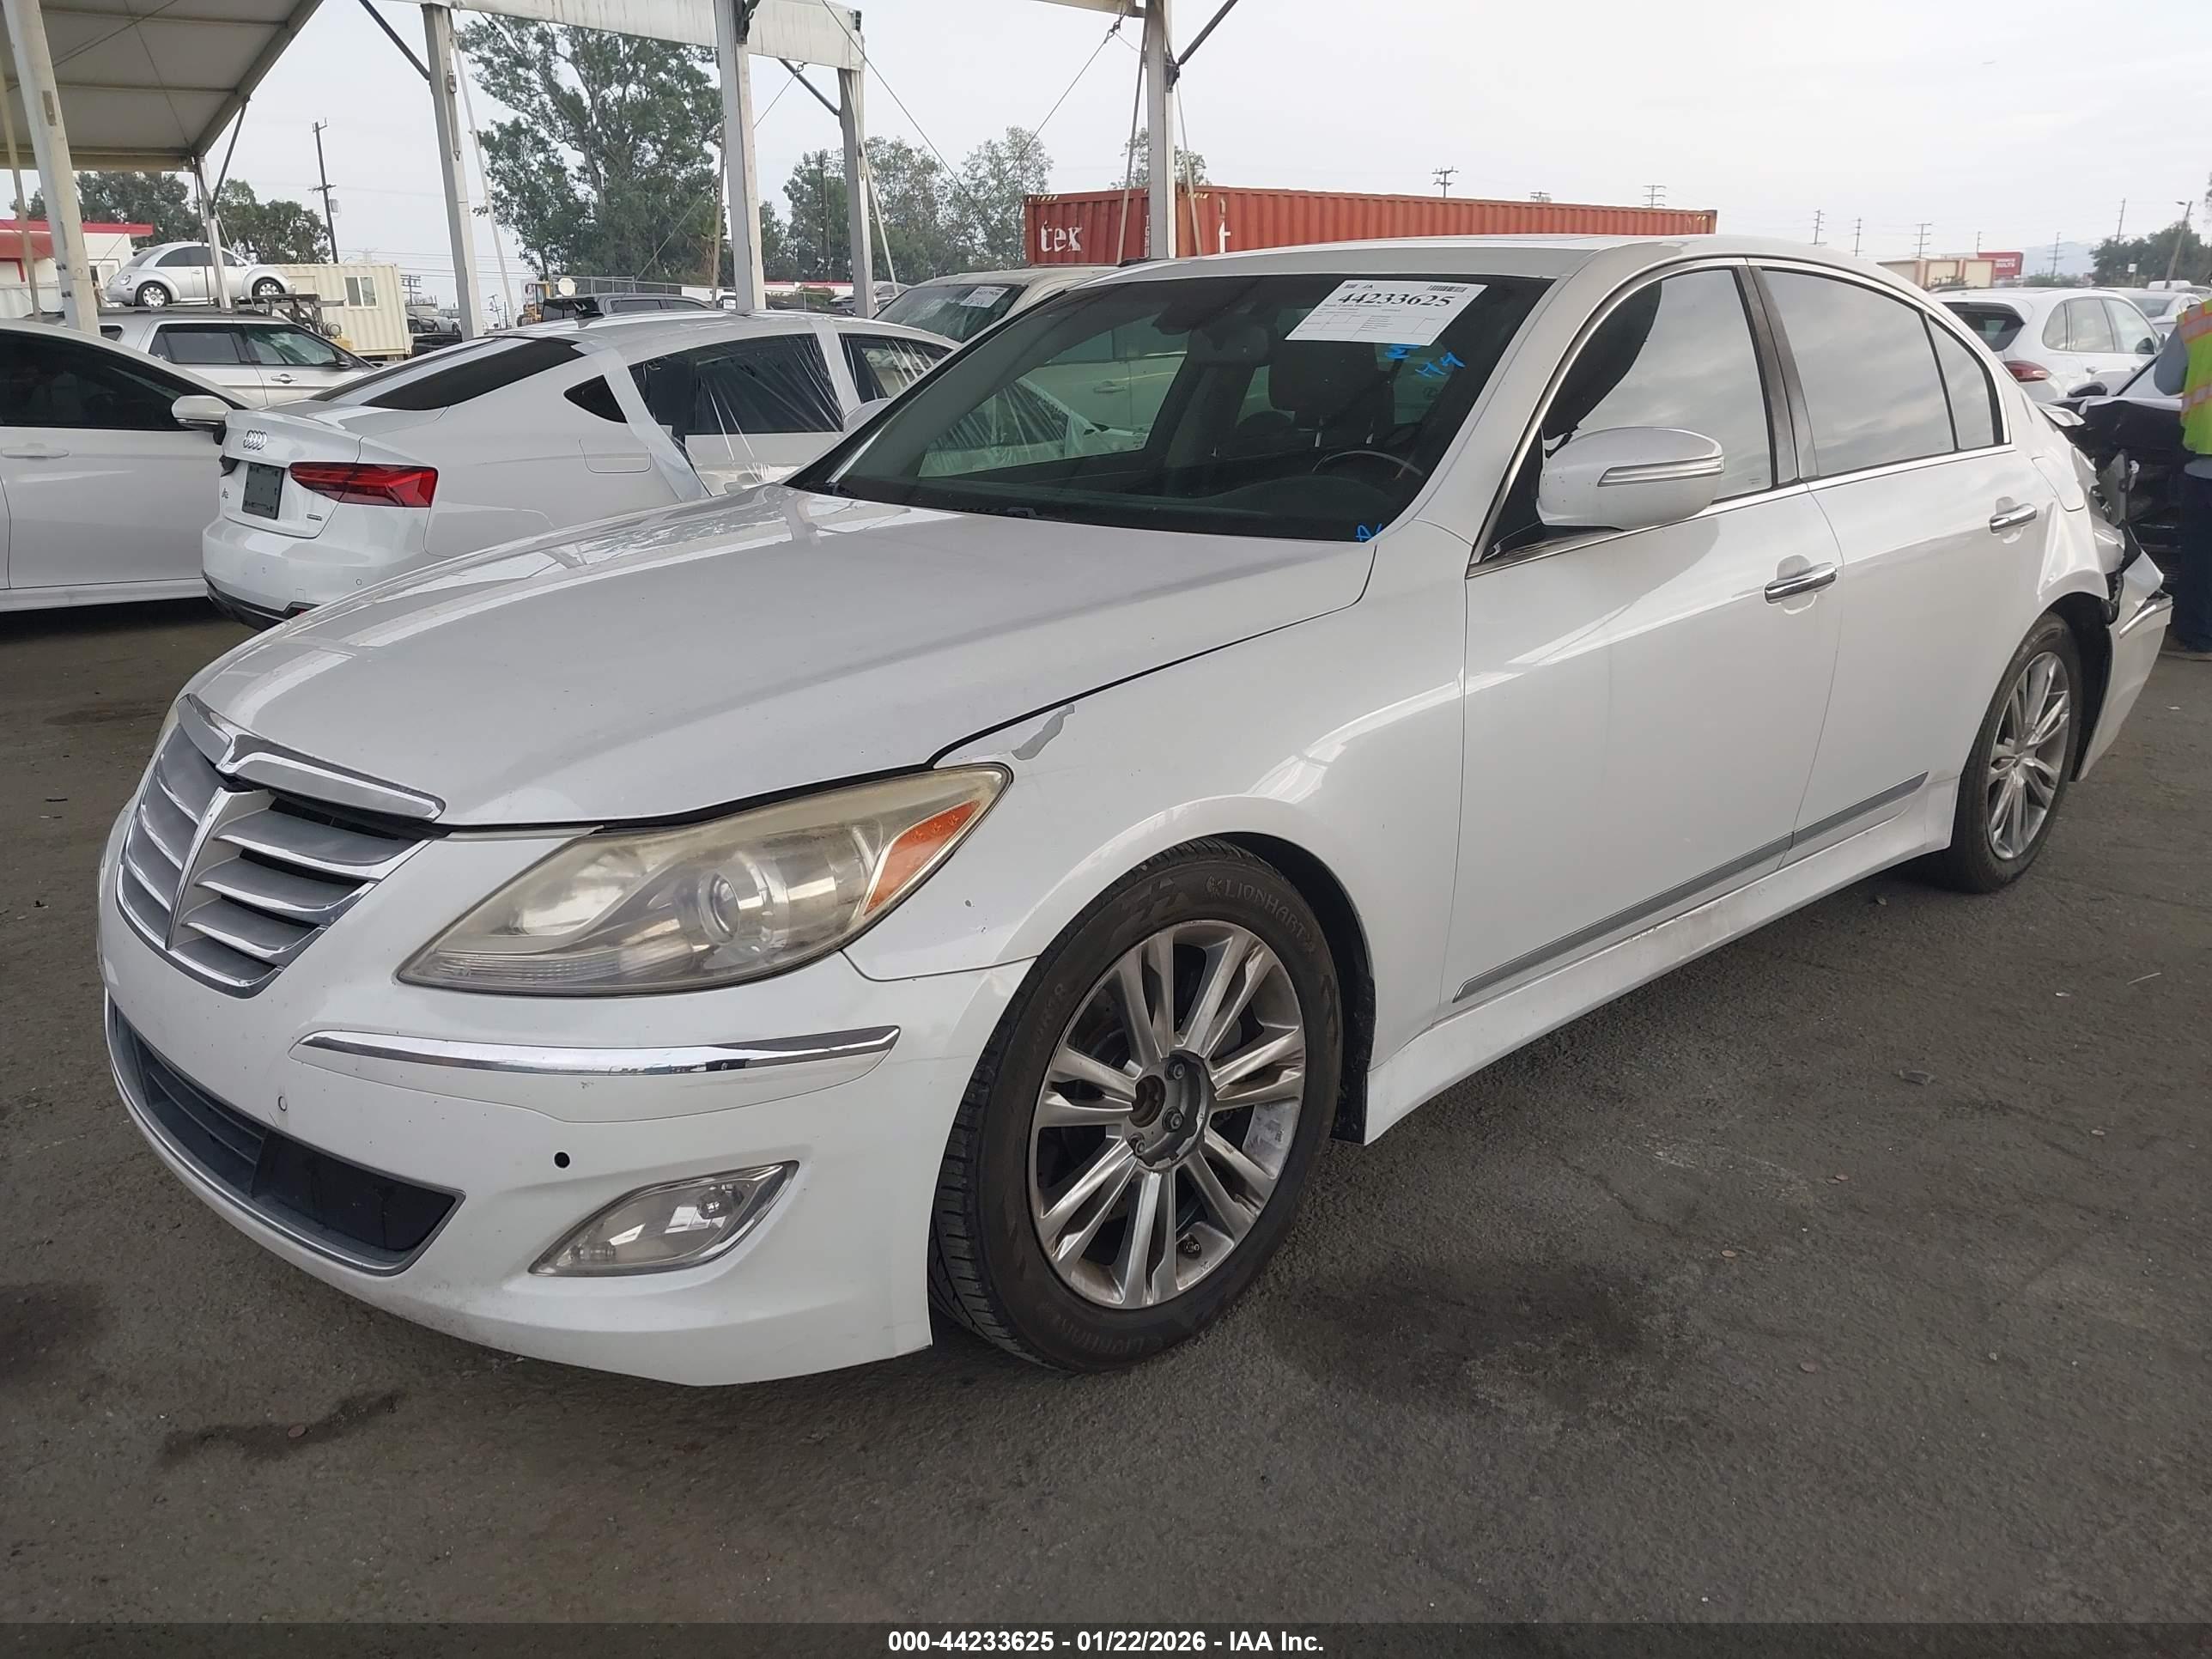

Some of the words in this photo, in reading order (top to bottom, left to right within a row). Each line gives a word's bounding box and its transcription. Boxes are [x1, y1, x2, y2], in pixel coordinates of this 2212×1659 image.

[1040, 220, 1083, 252] tex
[1337, 292, 1455, 308] 44233625
[1224, 879, 1306, 940] LIONHART
